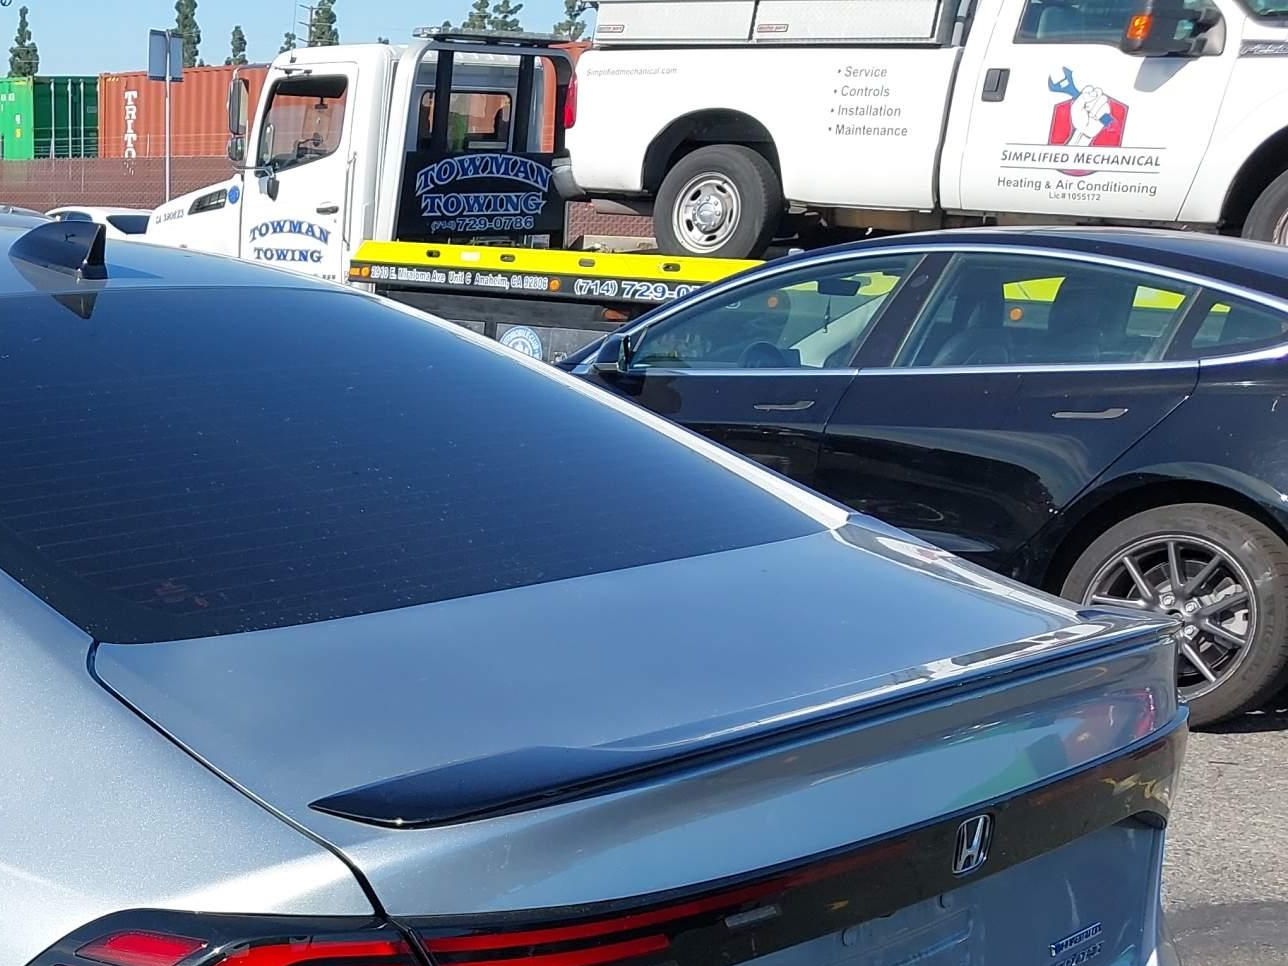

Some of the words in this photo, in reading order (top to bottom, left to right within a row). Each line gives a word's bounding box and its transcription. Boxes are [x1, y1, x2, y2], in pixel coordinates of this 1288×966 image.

[586, 67, 677, 77] Simplifiedmechanical.com
[844, 65, 887, 78] Service
[841, 84, 890, 97] Controls
[837, 104, 901, 117] Installation
[124, 90, 138, 160] TRITO
[835, 123, 908, 137] Maintenance
[1000, 149, 1069, 164] SIMPLIFIED
[1073, 152, 1161, 167] MECHANICAL
[415, 153, 552, 197] TOWMAN
[997, 176, 1041, 191] Heating
[1044, 180, 1051, 189] &
[1055, 179, 1073, 191] Air
[1077, 180, 1157, 197] Conditioning
[421, 191, 547, 217] TOWING
[249, 219, 332, 246] TOWMAN
[456, 215, 534, 232] 729-0786
[253, 247, 324, 263] TOWING
[431, 269, 446, 284] Ave
[448, 270, 464, 284] Unit
[473, 272, 510, 290] Anaheim,
[511, 276, 522, 289] CA
[574, 278, 618, 297] (714)
[621, 280, 700, 300] 729-0
